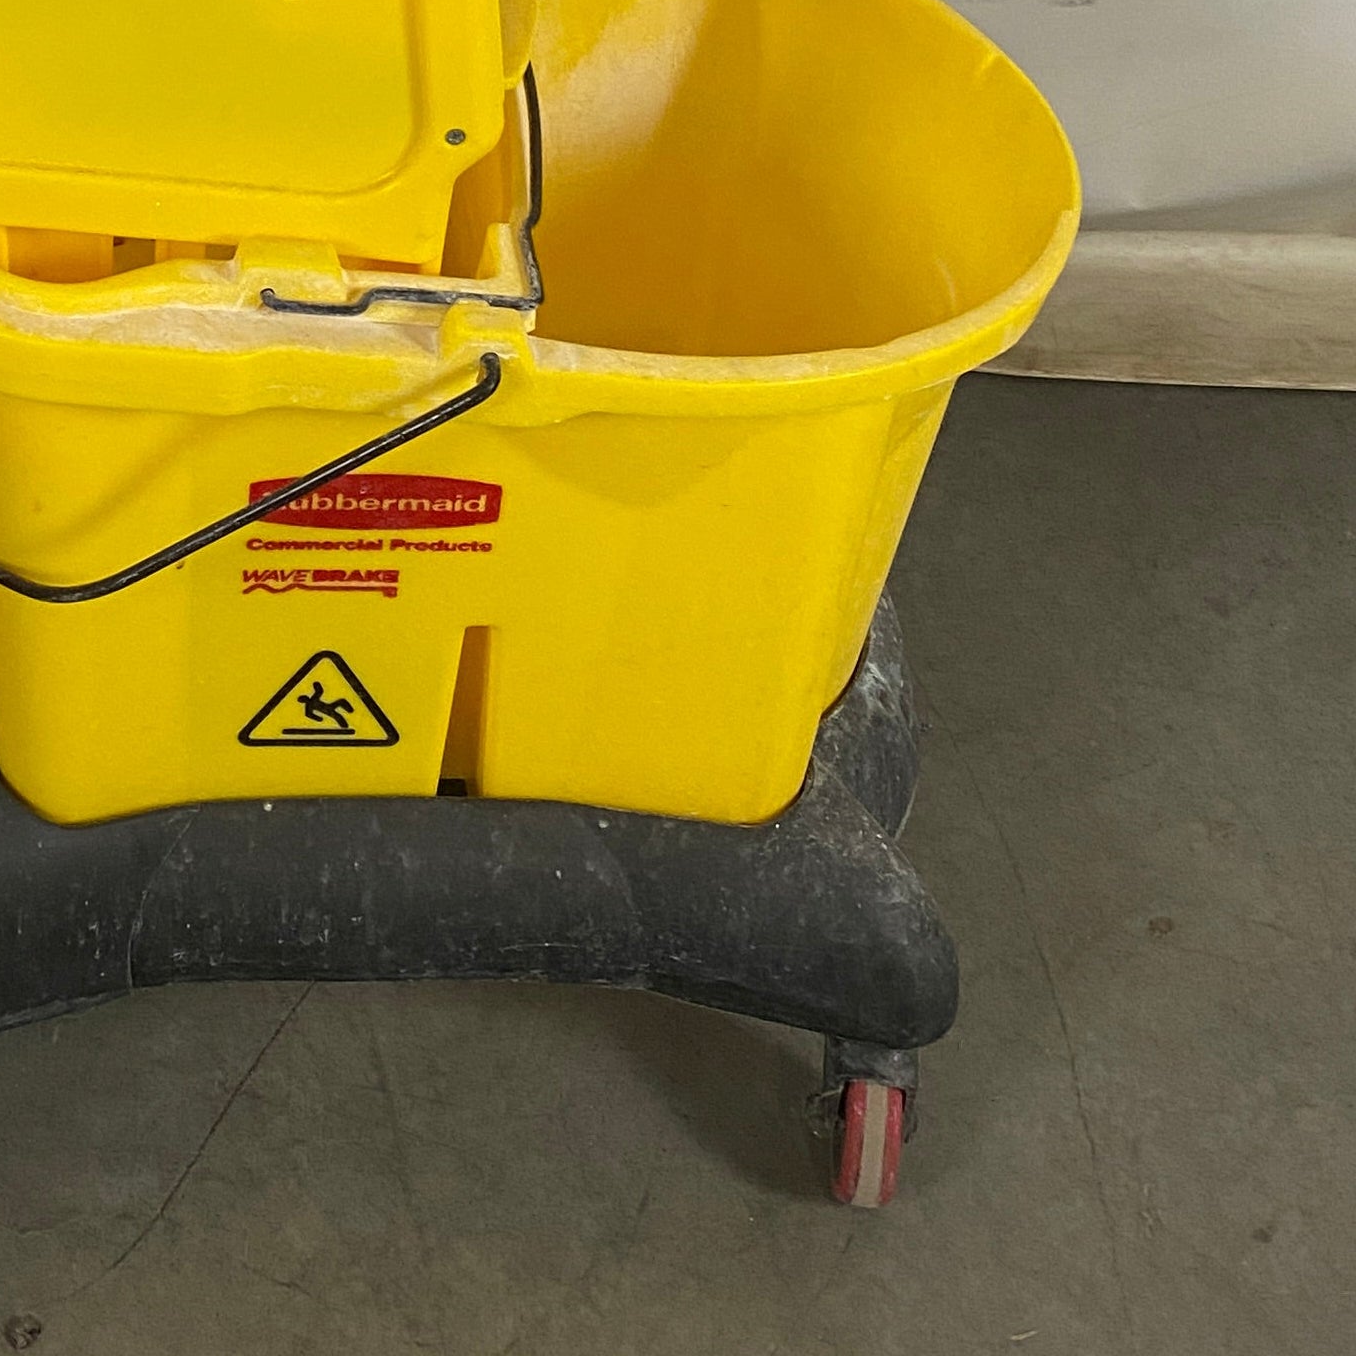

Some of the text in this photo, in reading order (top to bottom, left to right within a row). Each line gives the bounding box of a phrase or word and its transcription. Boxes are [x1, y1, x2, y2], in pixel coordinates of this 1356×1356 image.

[261, 491, 487, 513] ubbermaid
[245, 538, 493, 553] Commercial Products
